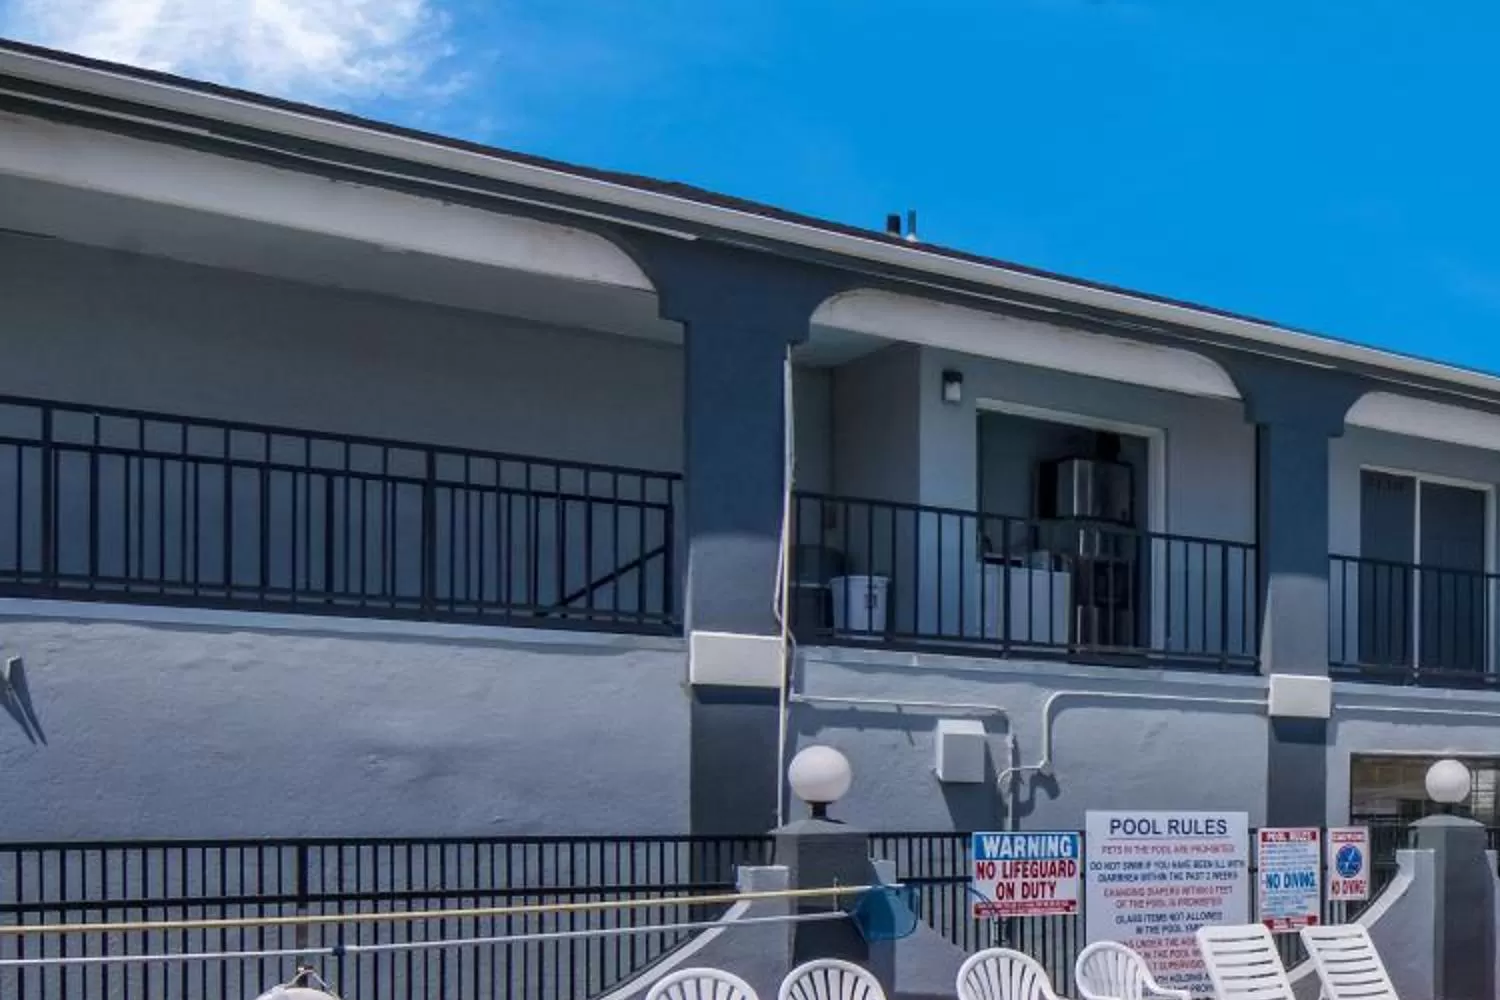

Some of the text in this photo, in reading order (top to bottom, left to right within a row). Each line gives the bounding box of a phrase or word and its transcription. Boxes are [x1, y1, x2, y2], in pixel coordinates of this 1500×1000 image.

[1109, 818, 1228, 836] POOL RULES
[983, 835, 1073, 858] WARNING
[976, 859, 1077, 880] NO LIFEGUARD
[995, 880, 1057, 901] ON DUTY
[1266, 873, 1280, 889] NO
